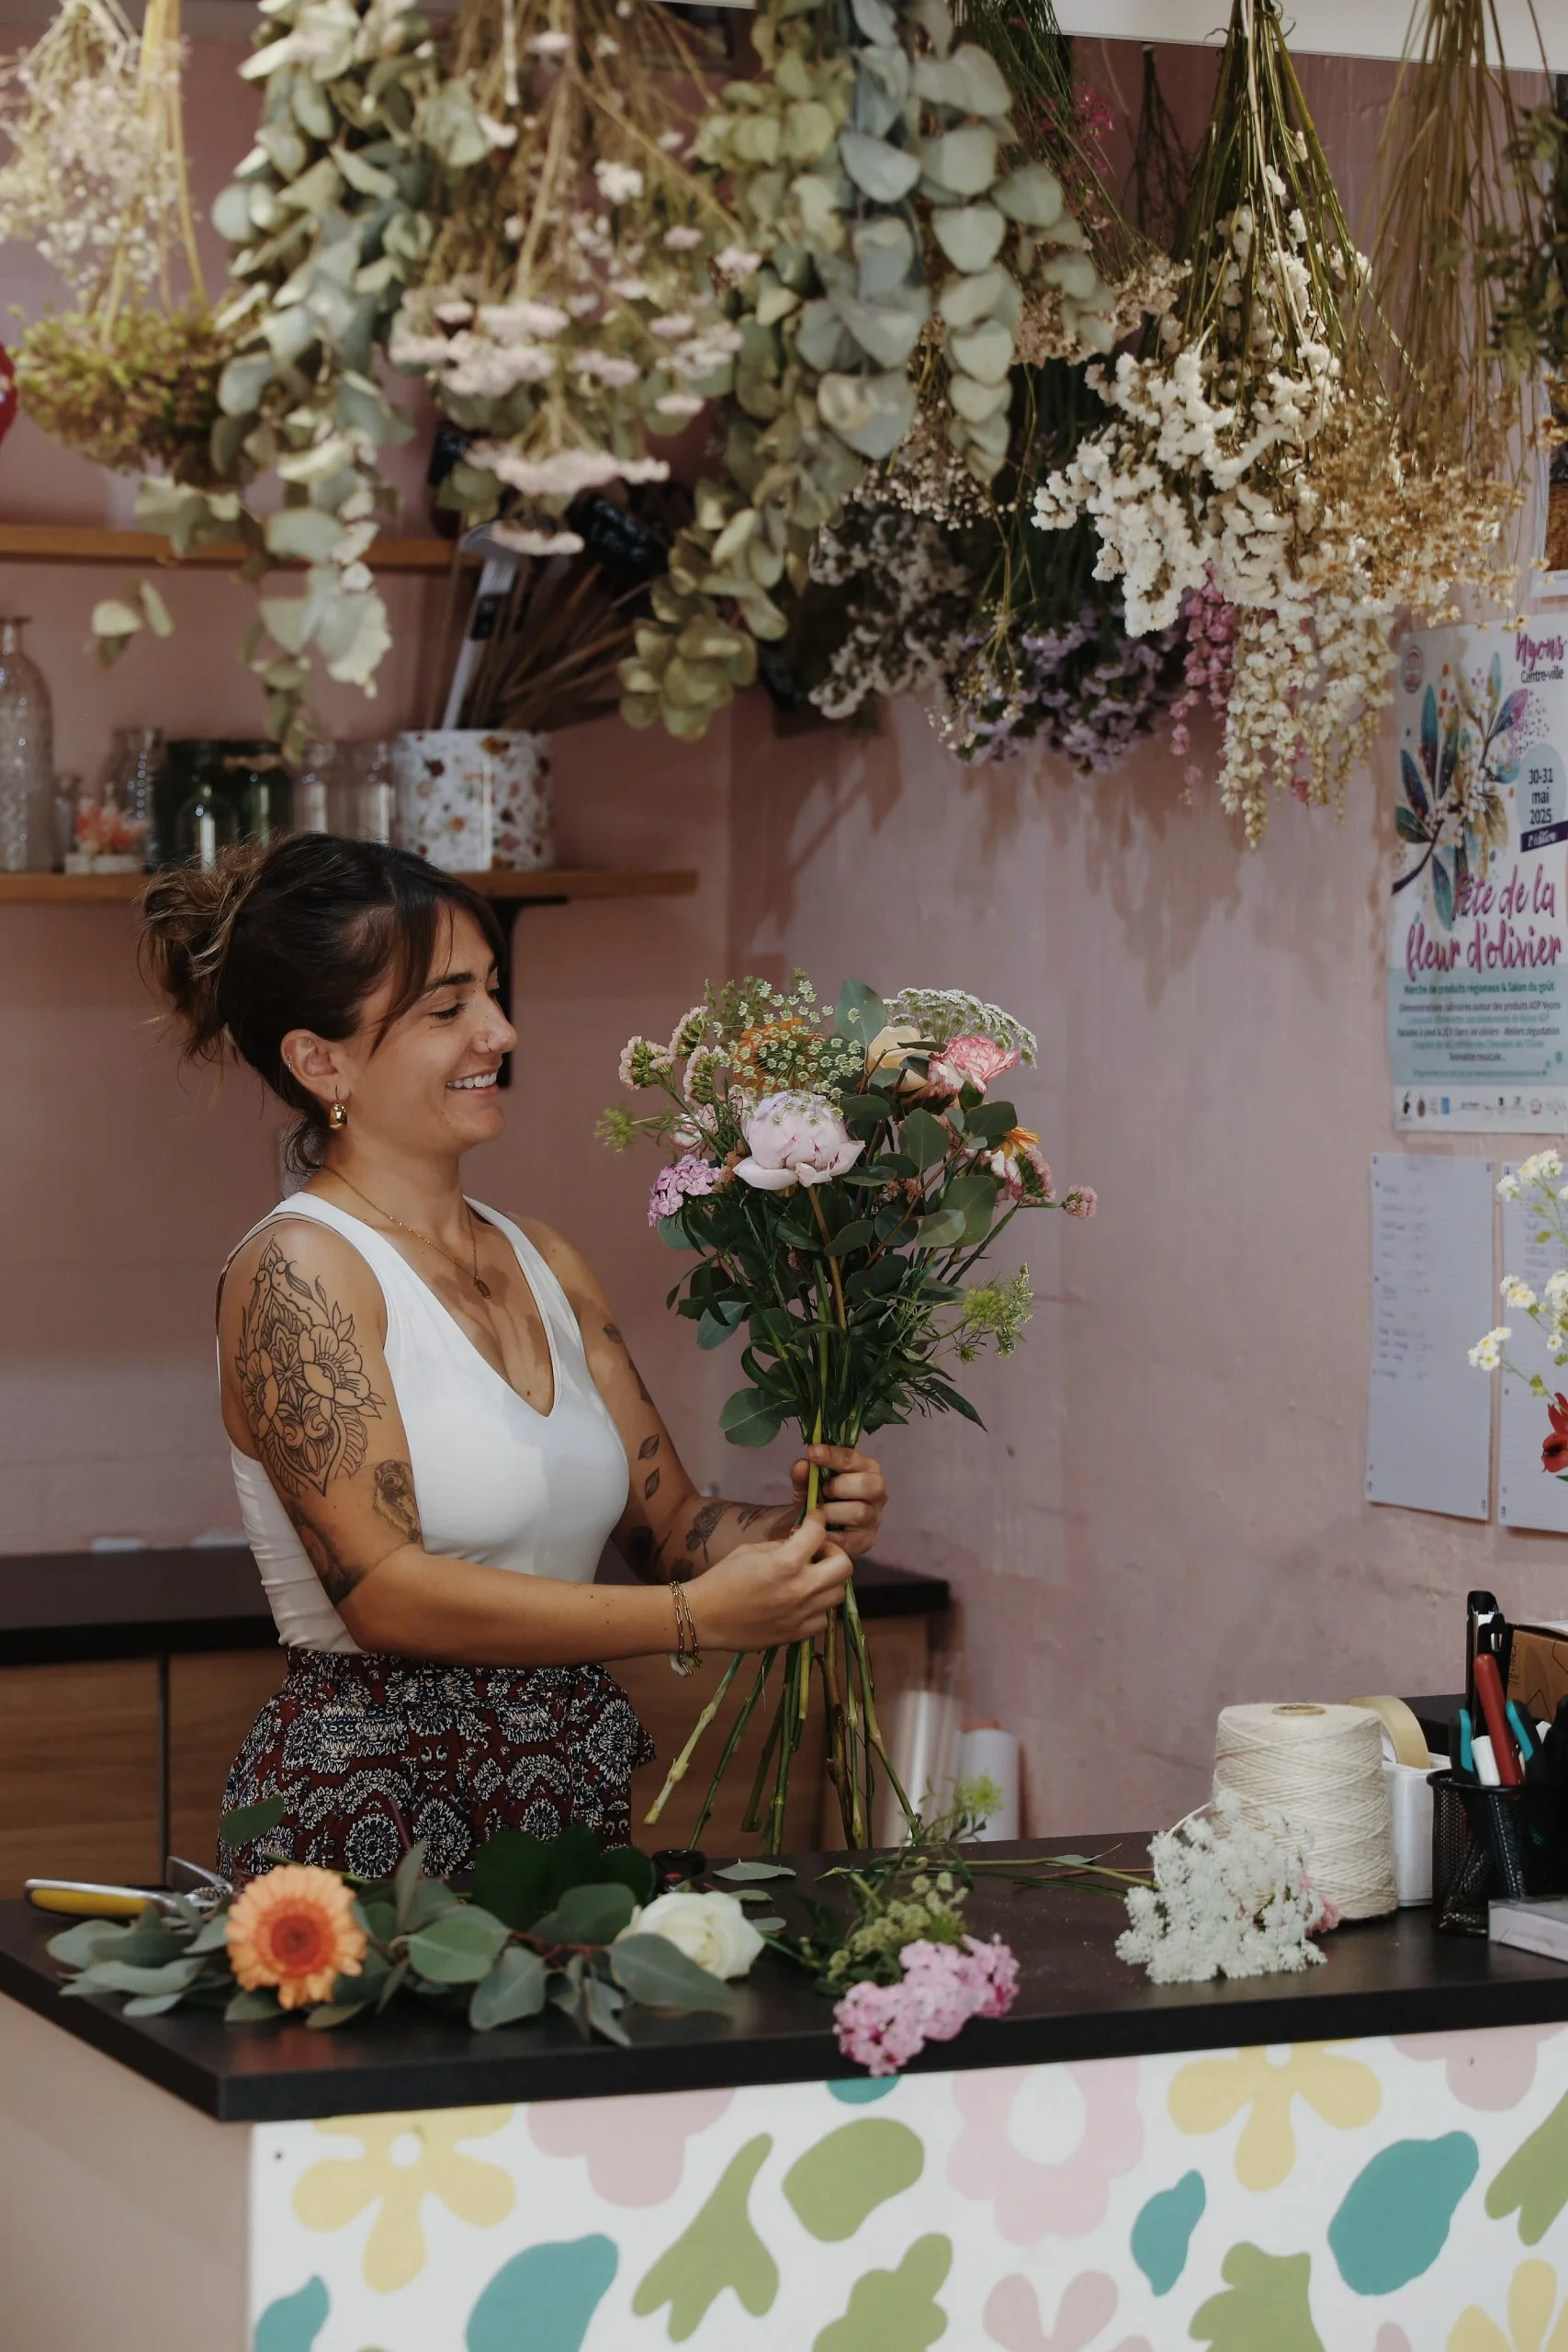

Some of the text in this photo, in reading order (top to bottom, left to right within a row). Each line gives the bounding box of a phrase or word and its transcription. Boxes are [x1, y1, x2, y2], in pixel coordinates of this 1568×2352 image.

[1520, 665, 1563, 684] Centre-ville
[1529, 768, 1553, 785] 30-31
[1531, 786, 1550, 805] mai
[1529, 808, 1552, 825] 2025
[1498, 864, 1529, 920] de
[1532, 863, 1555, 918] la
[1405, 919, 1562, 982] fleur d'olivier
[1507, 980, 1527, 992] Salon
[1528, 980, 1537, 992] du
